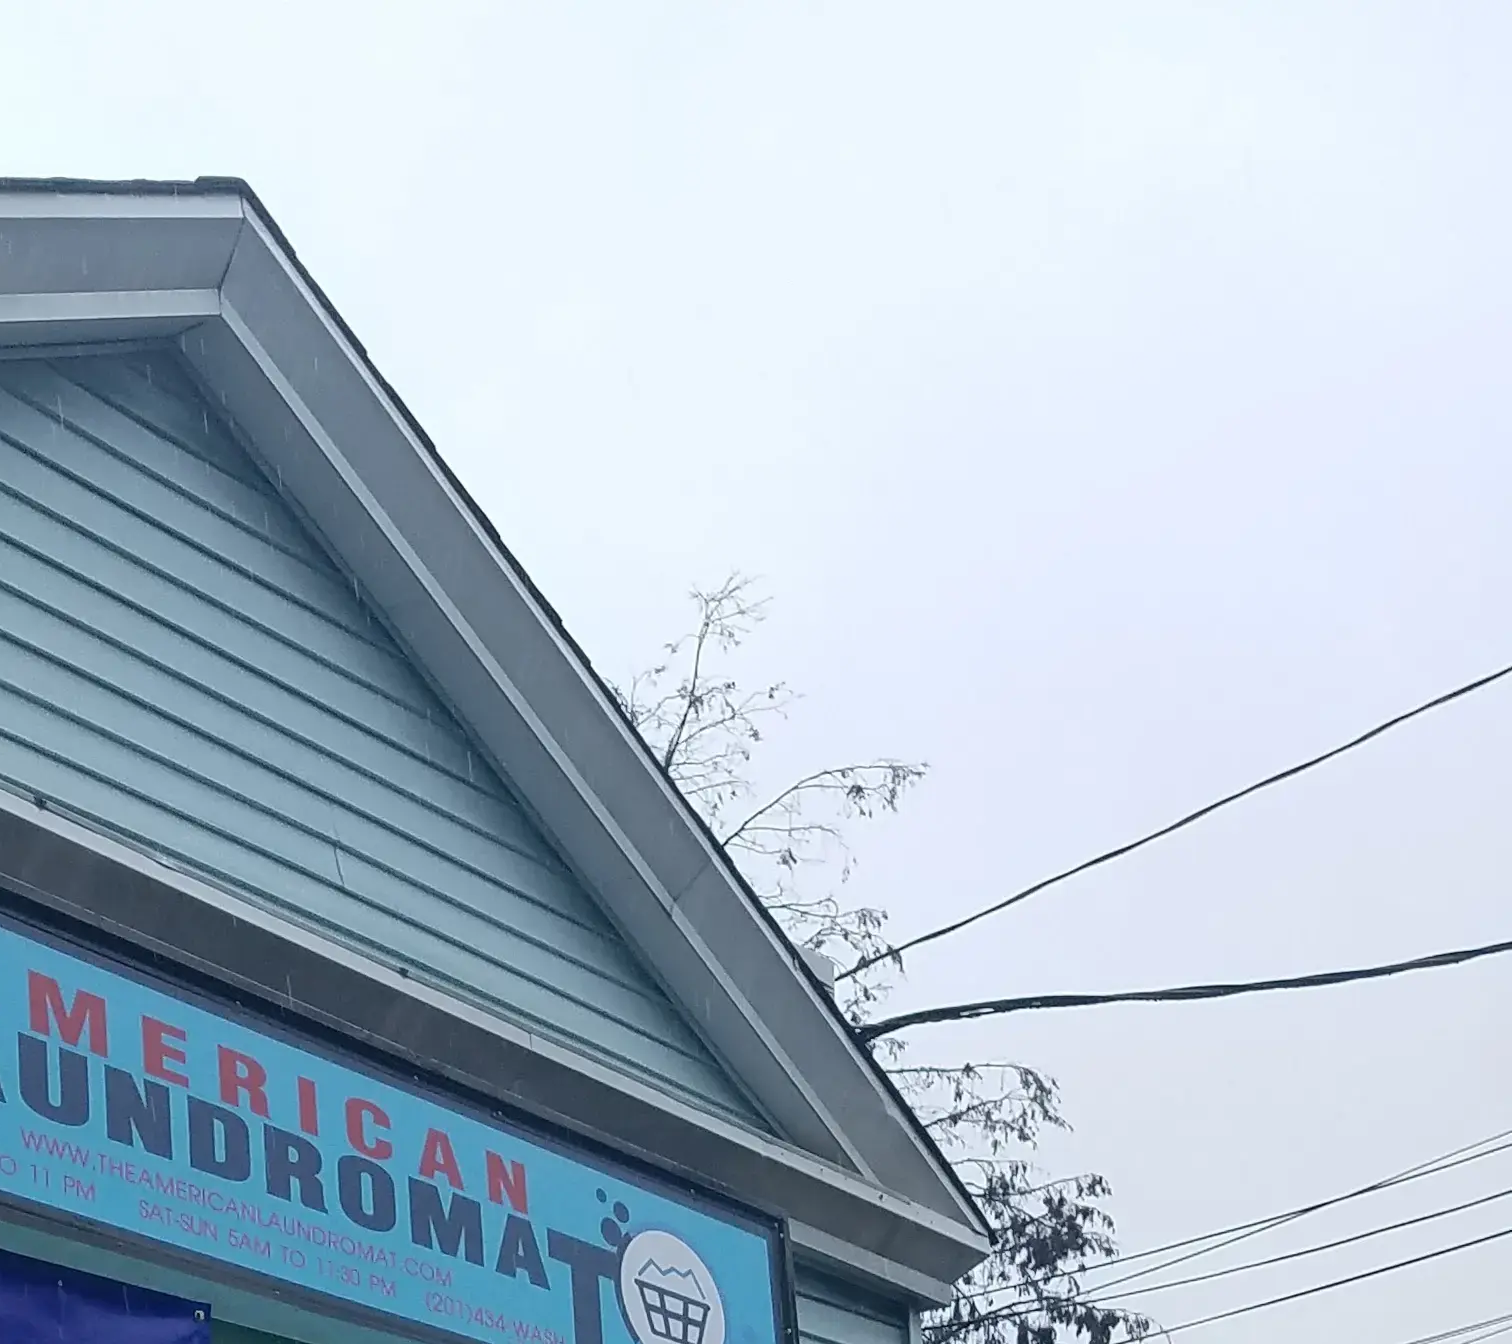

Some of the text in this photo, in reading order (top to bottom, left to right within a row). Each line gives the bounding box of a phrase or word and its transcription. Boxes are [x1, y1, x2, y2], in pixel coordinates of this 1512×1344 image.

[20, 1128, 453, 1288] WWW.THEAMERICANLAUNDROMAT.COM
[30, 1163, 50, 1188] 11
[64, 1175, 96, 1201] PM
[138, 1200, 218, 1243] SAT-SUN
[228, 1228, 271, 1259] 5AM
[281, 1246, 306, 1269] TO
[316, 1257, 361, 1287] 11:30
[369, 1275, 397, 1298] PM
